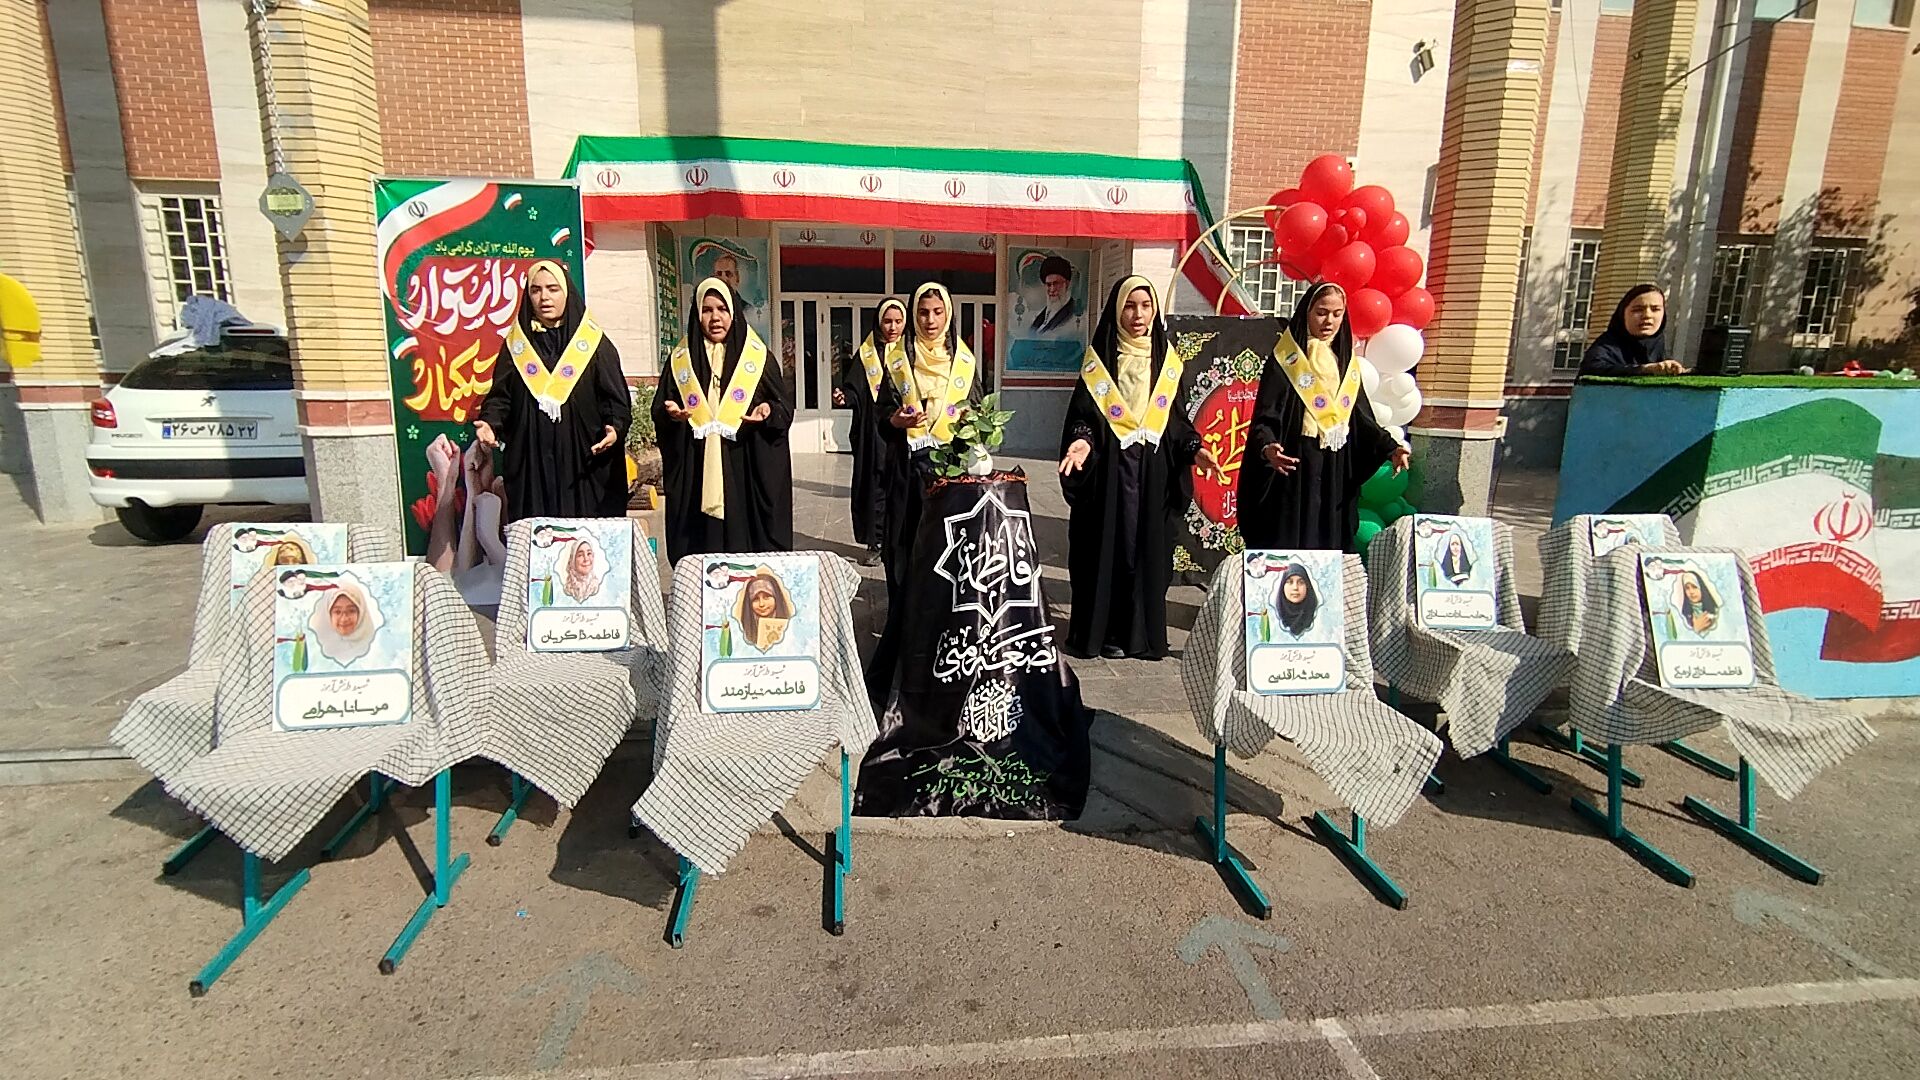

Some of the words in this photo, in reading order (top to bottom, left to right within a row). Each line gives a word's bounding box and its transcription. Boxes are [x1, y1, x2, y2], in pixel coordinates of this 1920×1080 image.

[435, 240, 447, 255] باد
[447, 240, 474, 256] گرامی
[473, 241, 490, 255] آبان
[502, 242, 518, 254] الله
[517, 245, 535, 257] یوم
[541, 628, 587, 644] ذاکریان
[587, 628, 621, 640] فاطمه
[1296, 668, 1331, 681] محدثه
[720, 682, 764, 700] نیازمند
[765, 680, 806, 695] فاطمه
[302, 700, 343, 720] بهرامی
[344, 698, 389, 716] مرسانا
